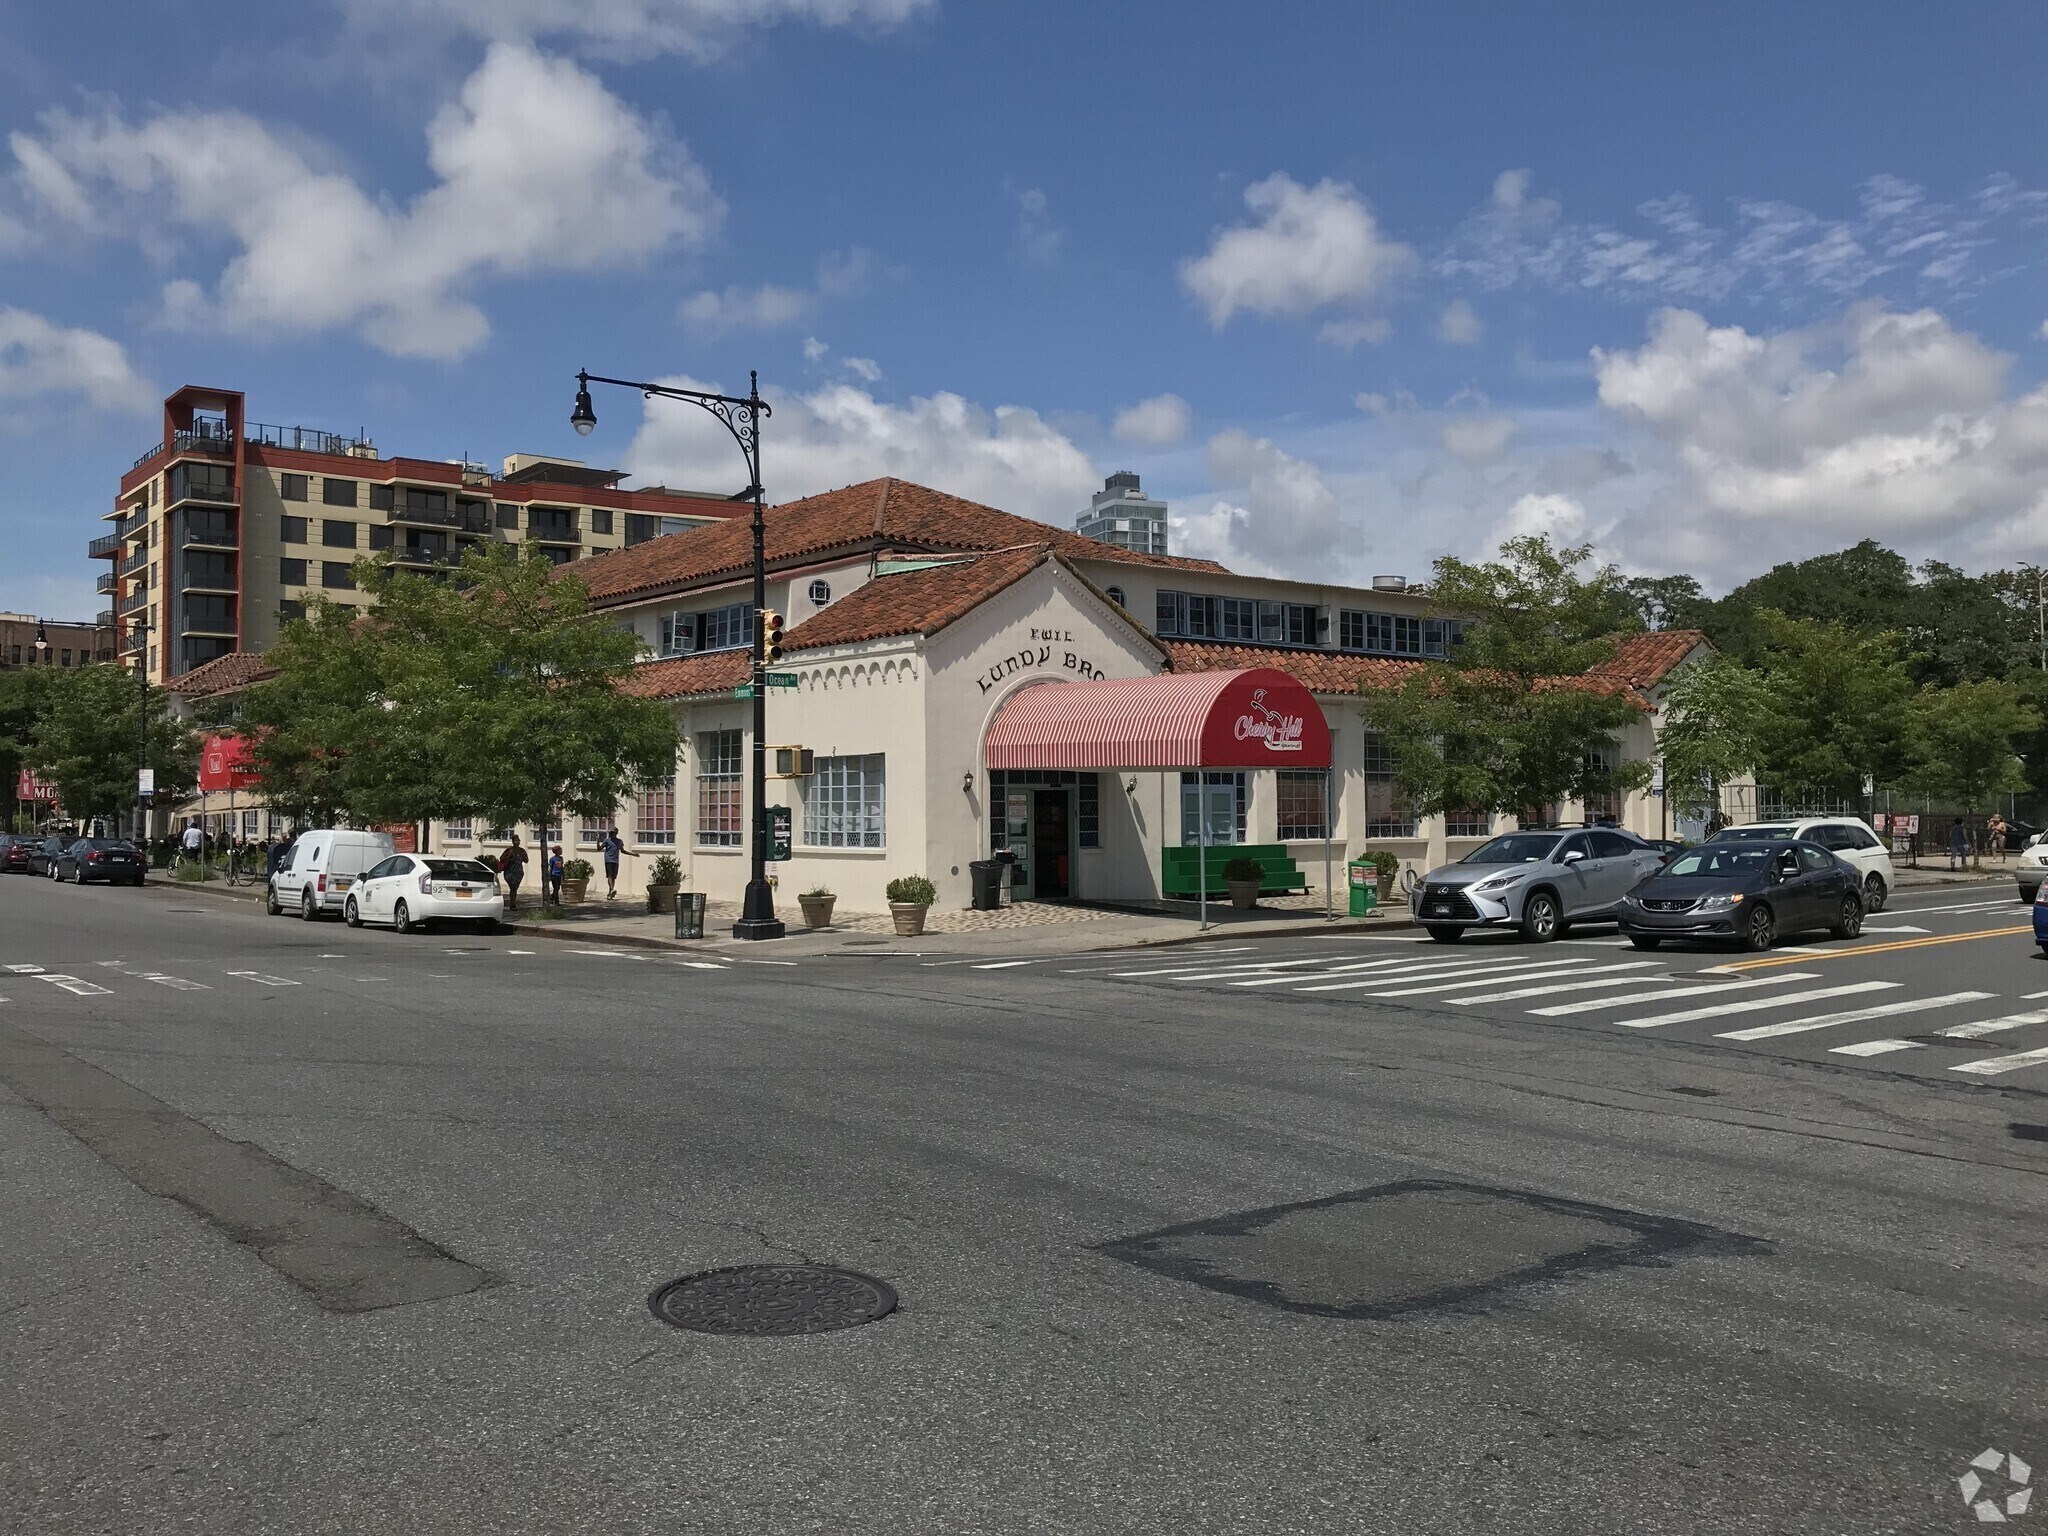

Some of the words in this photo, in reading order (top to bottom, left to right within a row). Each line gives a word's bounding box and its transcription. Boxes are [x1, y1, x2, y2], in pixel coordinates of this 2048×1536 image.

[769, 674, 789, 685] Ocean
[976, 645, 1051, 696] LUNDY
[1234, 715, 1276, 745] Cherry
[1276, 715, 1303, 742] Hill
[432, 886, 443, 894] 92
